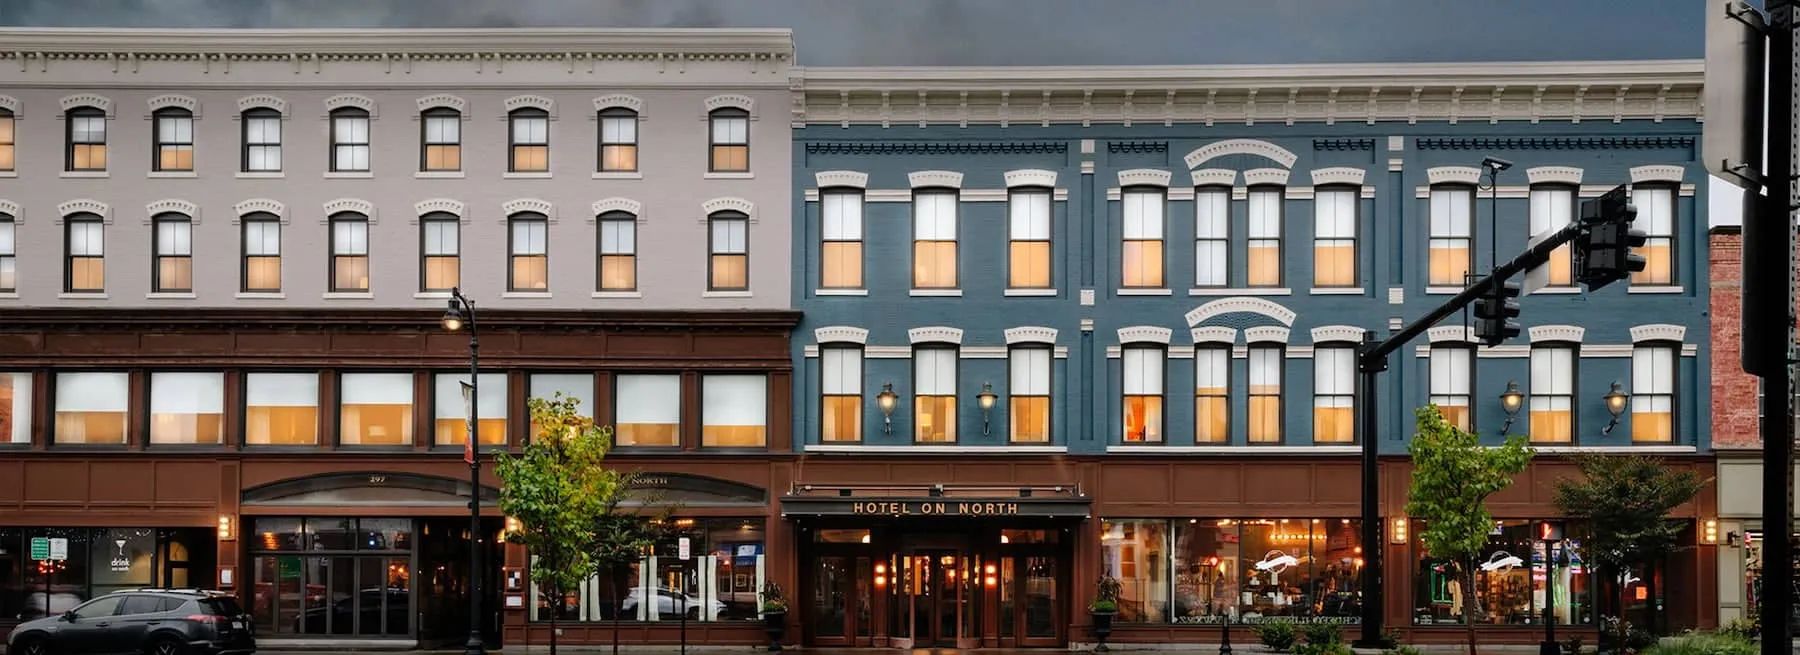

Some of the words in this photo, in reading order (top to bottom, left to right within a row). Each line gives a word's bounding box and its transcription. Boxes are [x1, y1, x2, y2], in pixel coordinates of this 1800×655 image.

[854, 502, 911, 515] HOTEL
[921, 503, 946, 515] ON
[959, 503, 1018, 515] NORTH
[111, 558, 130, 567] drink
